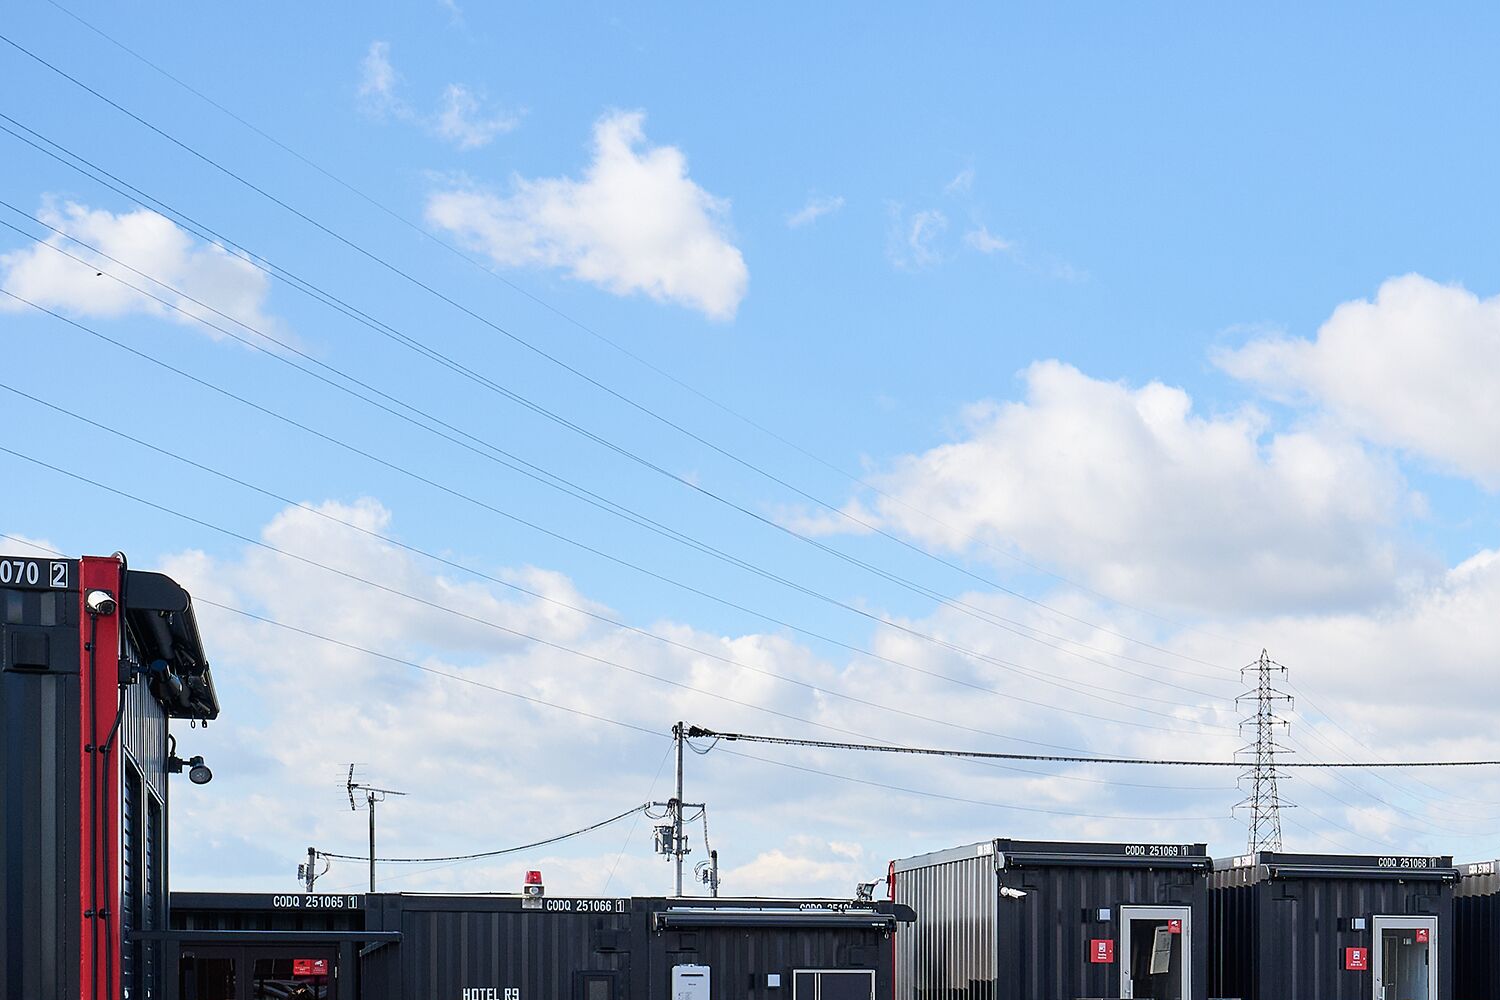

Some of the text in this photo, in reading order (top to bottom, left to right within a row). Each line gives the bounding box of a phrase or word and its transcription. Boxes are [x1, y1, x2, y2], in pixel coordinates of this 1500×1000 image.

[0, 560, 67, 587] 070 2
[1149, 846, 1178, 856] 251069
[273, 895, 300, 907] CODQ
[305, 896, 344, 908] 251065
[546, 900, 571, 911] CODQ
[576, 900, 612, 912] 251066
